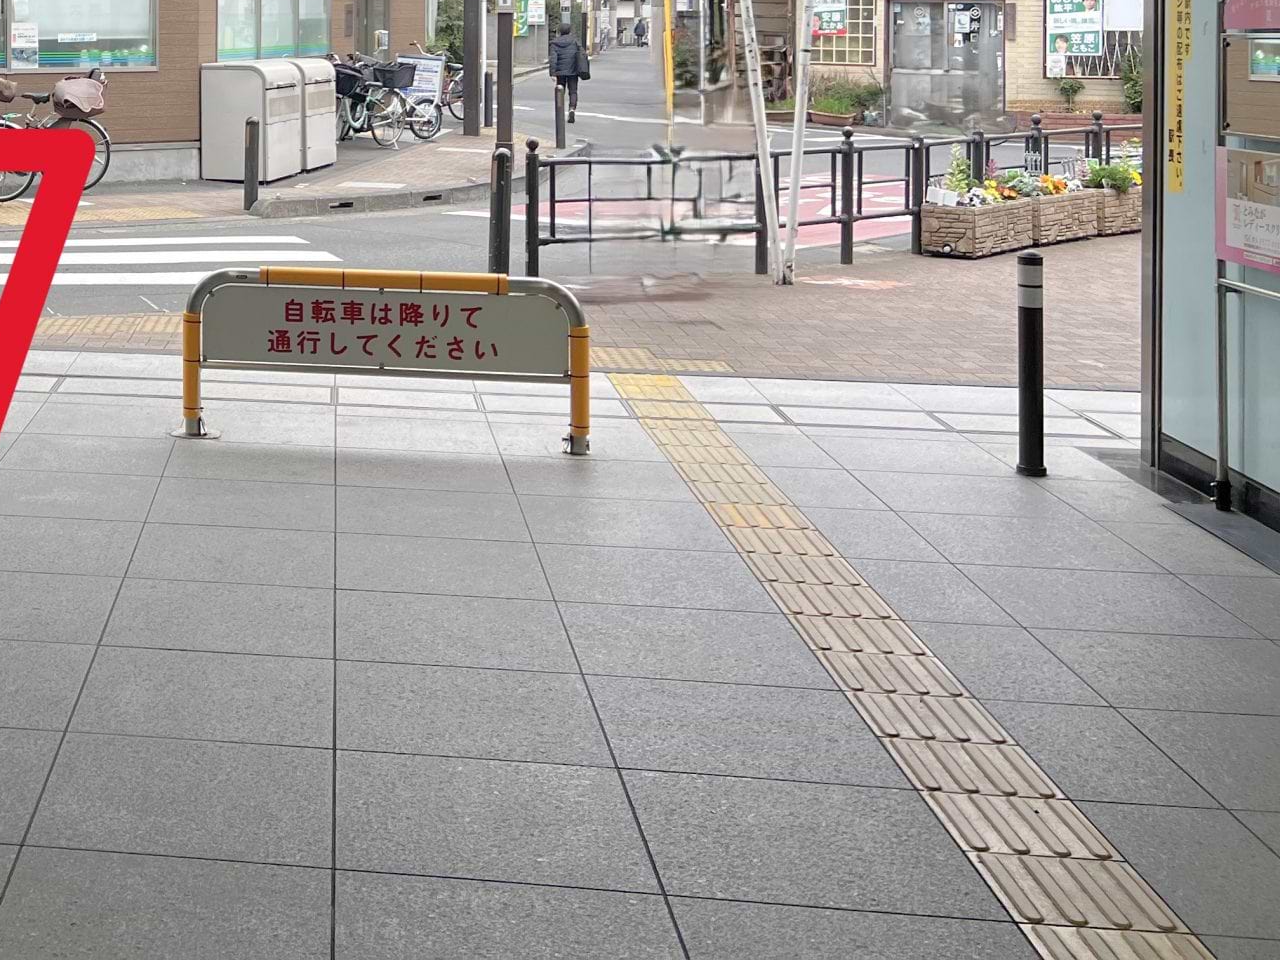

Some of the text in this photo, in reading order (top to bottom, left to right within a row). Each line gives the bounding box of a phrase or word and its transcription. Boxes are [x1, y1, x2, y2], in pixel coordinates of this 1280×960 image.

[1072, 44, 1096, 52] ともこ
[284, 299, 484, 328] 自転車は降りて
[267, 329, 499, 360] 通行してください
